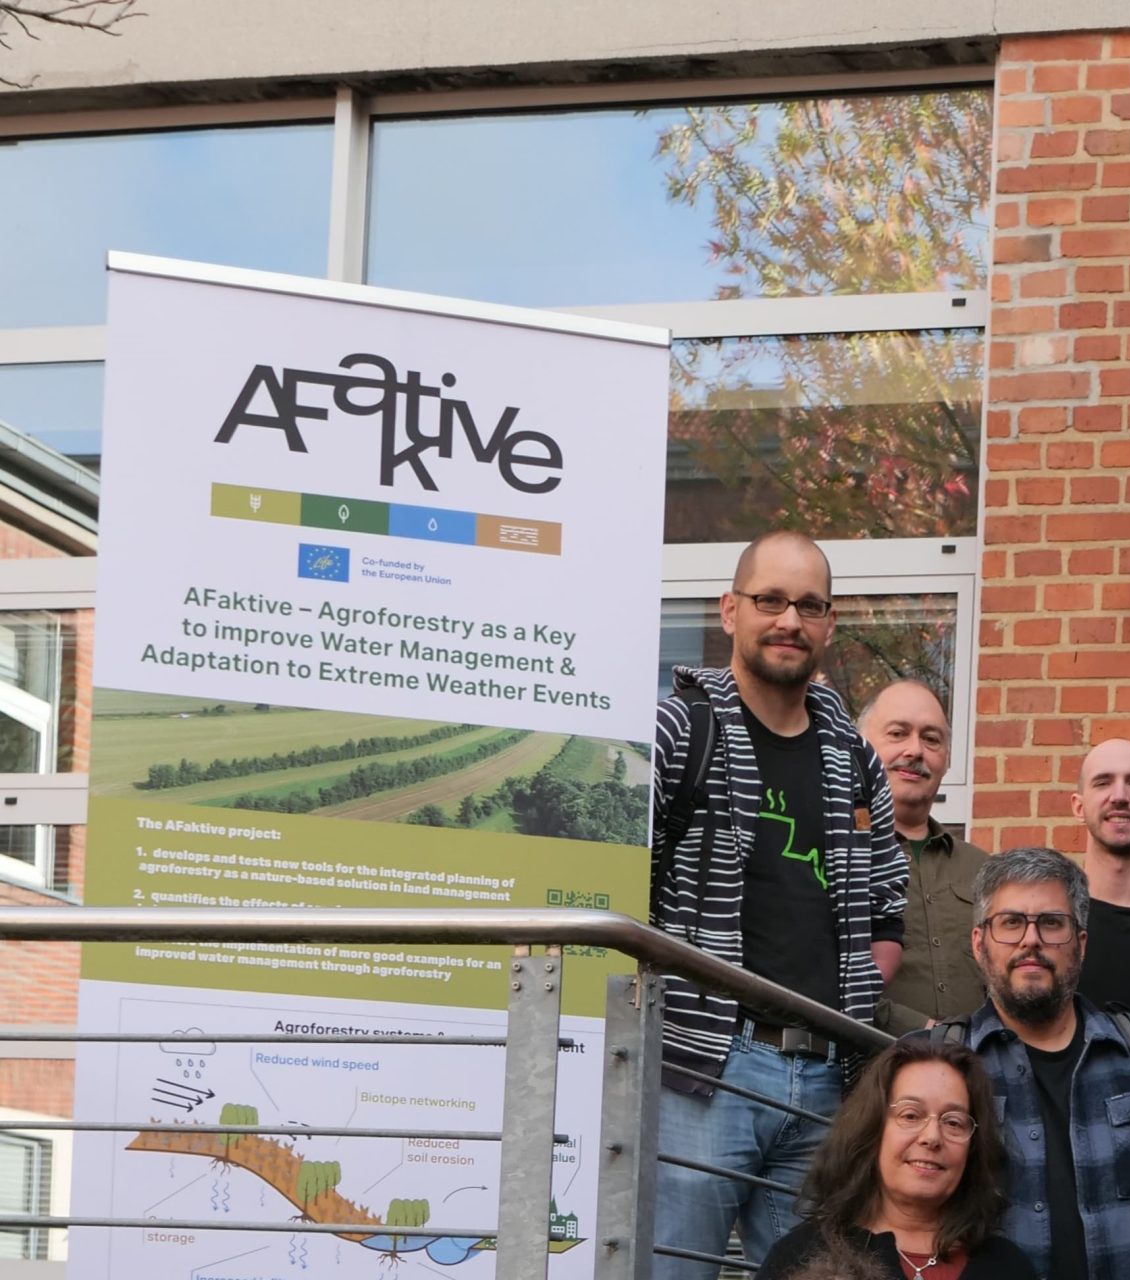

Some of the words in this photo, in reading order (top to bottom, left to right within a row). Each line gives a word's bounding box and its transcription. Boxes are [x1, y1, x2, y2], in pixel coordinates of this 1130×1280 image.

[362, 557, 411, 570] Co-funded
[413, 562, 425, 572] by
[361, 569, 377, 577] the
[379, 570, 423, 583] European
[425, 575, 452, 585] Union
[183, 586, 293, 617] AFaktive
[317, 601, 474, 640] Agroforestry
[481, 623, 507, 640] as
[512, 625, 527, 642] a
[533, 622, 577, 651] Key
[181, 617, 207, 639] to
[214, 620, 314, 652] improve
[320, 630, 393, 658] Water
[399, 639, 554, 680] Management
[559, 655, 577, 677] &
[141, 643, 280, 677] Adaptation
[286, 655, 312, 679] to
[318, 661, 420, 690] Extreme
[425, 672, 527, 701] Weather
[532, 683, 612, 711] Events
[136, 817, 162, 830] The
[165, 820, 226, 835] AFaktive
[228, 825, 281, 840] project:
[136, 847, 147, 857] 1.
[153, 848, 211, 863] develops
[212, 854, 236, 865] and
[238, 855, 271, 868] tests
[273, 859, 299, 870] new
[301, 860, 334, 873] tools
[335, 863, 354, 874] for
[356, 865, 378, 877] the
[379, 867, 445, 882] integrated
[447, 873, 499, 889] planning
[501, 878, 516, 888] of
[138, 861, 222, 879] agroforestry
[224, 868, 239, 879] as
[240, 870, 249, 880] a
[250, 871, 335, 887] nature-based
[336, 878, 387, 891] solution
[389, 882, 401, 893] in
[403, 883, 430, 895] land
[432, 887, 511, 901] management
[133, 889, 145, 899] 2.
[151, 891, 217, 905] quantifies
[218, 895, 240, 907] the
[135, 945, 196, 961] improved
[198, 952, 235, 963] water
[237, 956, 319, 970] management
[321, 961, 370, 975] through
[372, 966, 452, 982] agroforestry
[323, 947, 337, 957] of
[339, 949, 371, 960] more
[373, 951, 404, 962] good
[406, 954, 464, 967] examples
[466, 957, 484, 968] for
[486, 960, 502, 970] an
[255, 1053, 309, 1067] Reduced
[312, 1056, 340, 1069] wind
[342, 1059, 380, 1072] speed
[360, 1092, 407, 1107] Biotope
[409, 1096, 477, 1112] networking
[407, 1138, 460, 1150] Reduced
[407, 1152, 429, 1163] soil
[430, 1155, 475, 1166] erosion
[147, 1232, 196, 1245] storage
